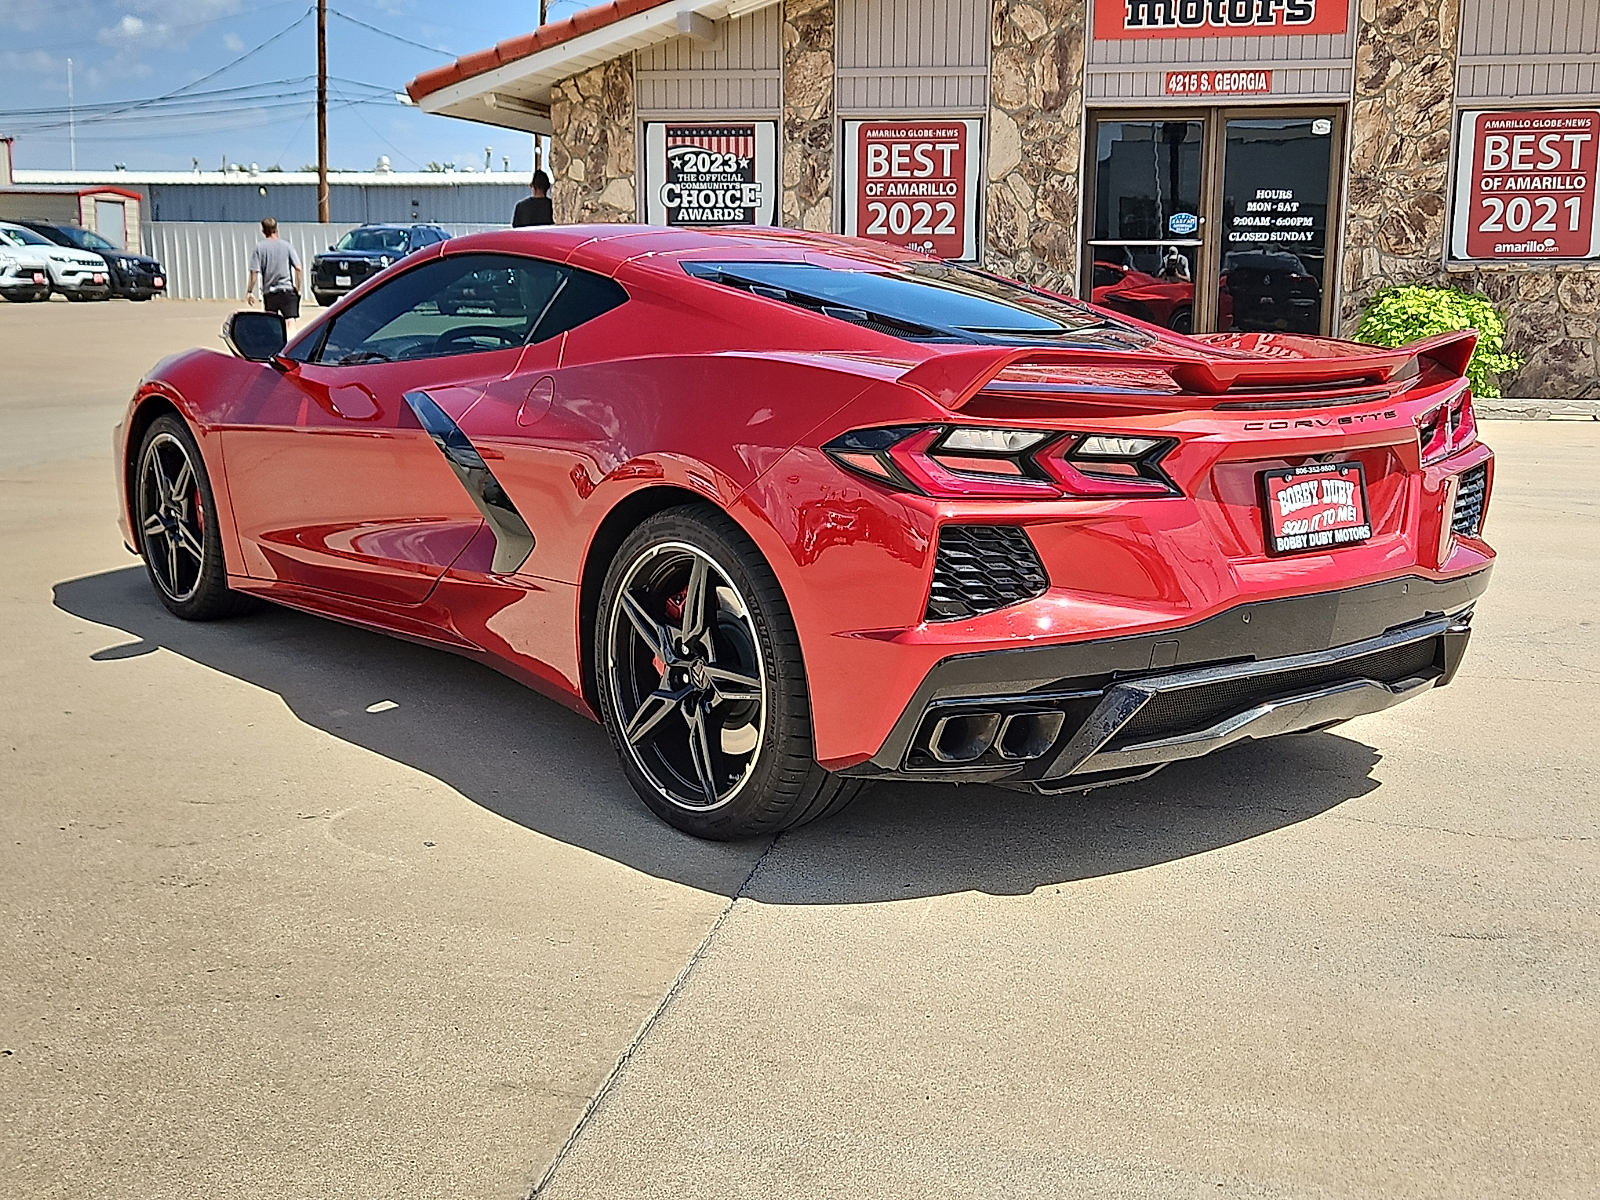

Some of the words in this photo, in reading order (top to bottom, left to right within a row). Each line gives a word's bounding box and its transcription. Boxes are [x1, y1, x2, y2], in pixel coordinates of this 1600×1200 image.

[1168, 73, 1198, 92] 4215
[1200, 74, 1211, 92] S.
[1214, 72, 1267, 91] GEORGIA
[866, 129, 907, 138] AMARILLO
[908, 129, 959, 137] GLOBE-NEWS
[1484, 120, 1531, 129] AMARILLO
[1532, 118, 1592, 127] GLOBE-NEWS
[867, 143, 960, 177] BEST
[1483, 133, 1592, 171] BEST
[683, 153, 738, 173] 2023
[677, 173, 697, 182] THE
[698, 173, 744, 182] OFFICIAL
[680, 182, 741, 190] COMMUNITY'S
[1480, 177, 1503, 191] OF
[1504, 176, 1586, 190] AMARILLO
[660, 182, 762, 208] CHOICE
[865, 182, 885, 196] OF
[886, 182, 957, 196] AMARILLO
[1255, 189, 1293, 200] HOURS
[677, 208, 745, 220] AWARDS
[866, 201, 956, 235] 2022
[1478, 196, 1581, 232] 2021
[1228, 232, 1270, 242] CLOSED
[1270, 231, 1315, 241] SUNDAY
[1494, 240, 1560, 253] amarillo.com
[1243, 409, 1397, 431] CORVETTE
[1277, 480, 1319, 517] BOBBY
[1321, 479, 1355, 506] DUBY
[1281, 518, 1309, 536] SOLD
[1310, 513, 1322, 532] IT
[1321, 508, 1336, 527] TO
[1276, 533, 1308, 552] BOBBY
[1308, 530, 1333, 547] DUBY
[1334, 525, 1371, 544] MOTORS
[748, 594, 776, 678] MICHELIN
